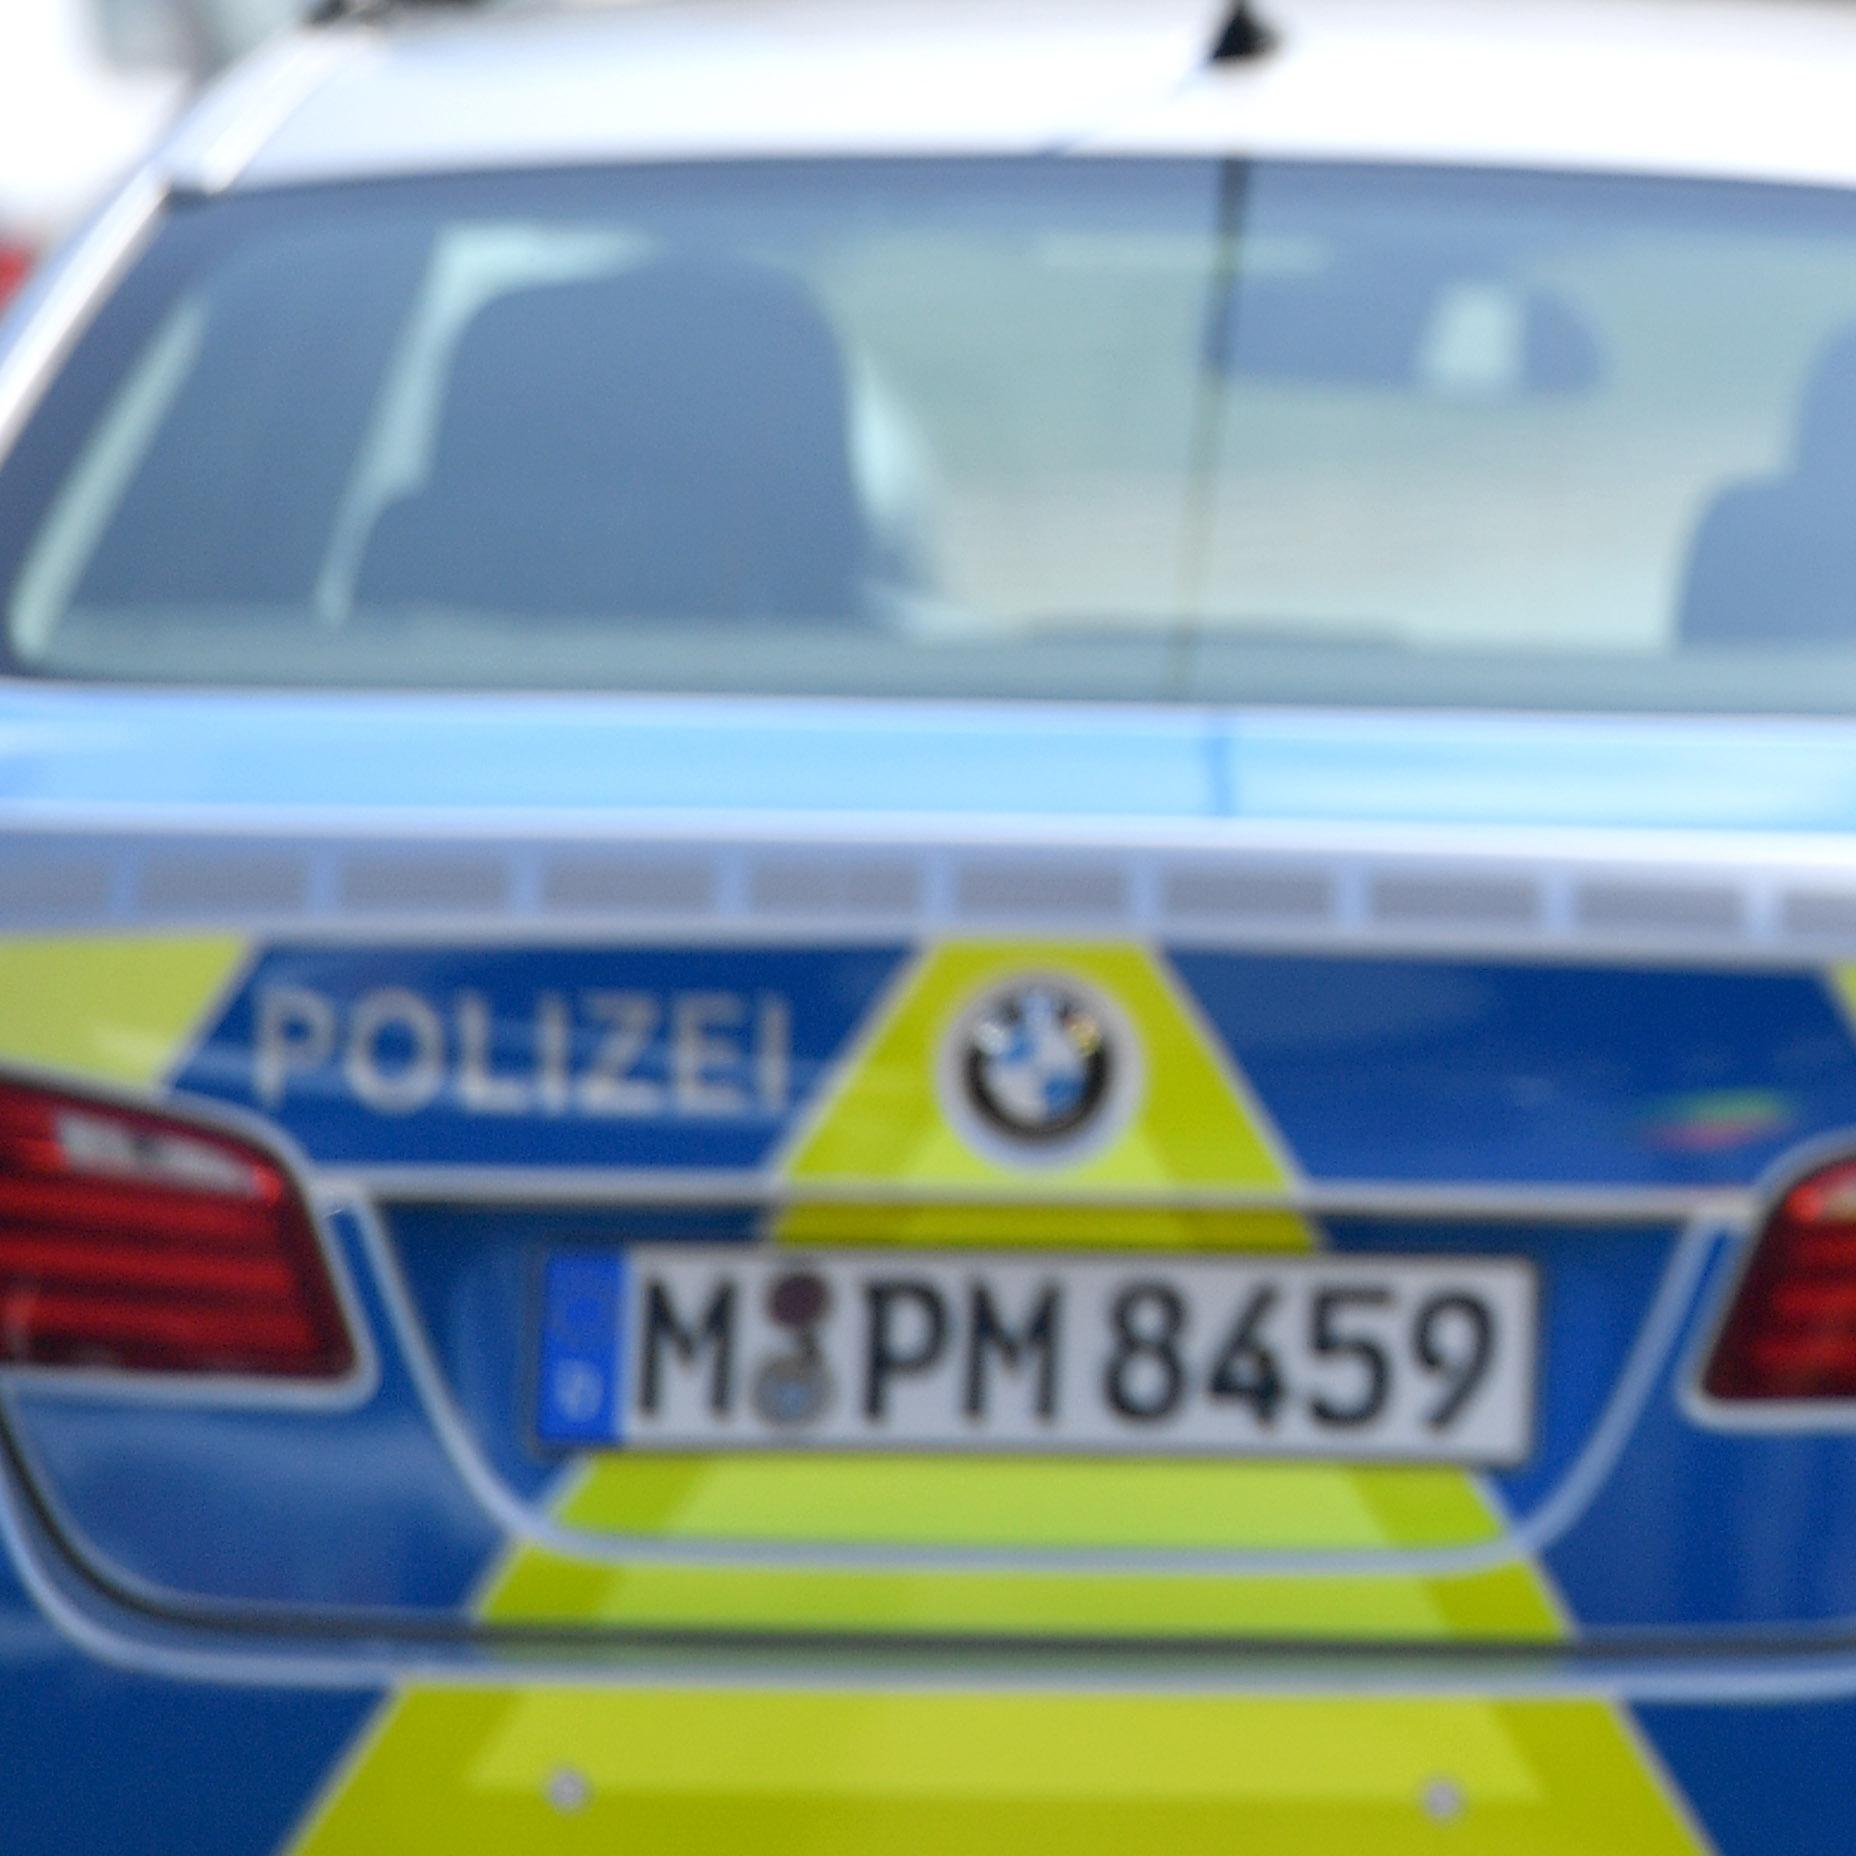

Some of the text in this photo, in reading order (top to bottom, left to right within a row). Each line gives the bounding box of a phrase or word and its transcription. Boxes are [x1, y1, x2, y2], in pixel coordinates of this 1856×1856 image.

[250, 984, 793, 1118] POLIZEI
[635, 1275, 736, 1421] M
[861, 1278, 1062, 1424] PM
[1102, 1280, 1498, 1432] 8459
